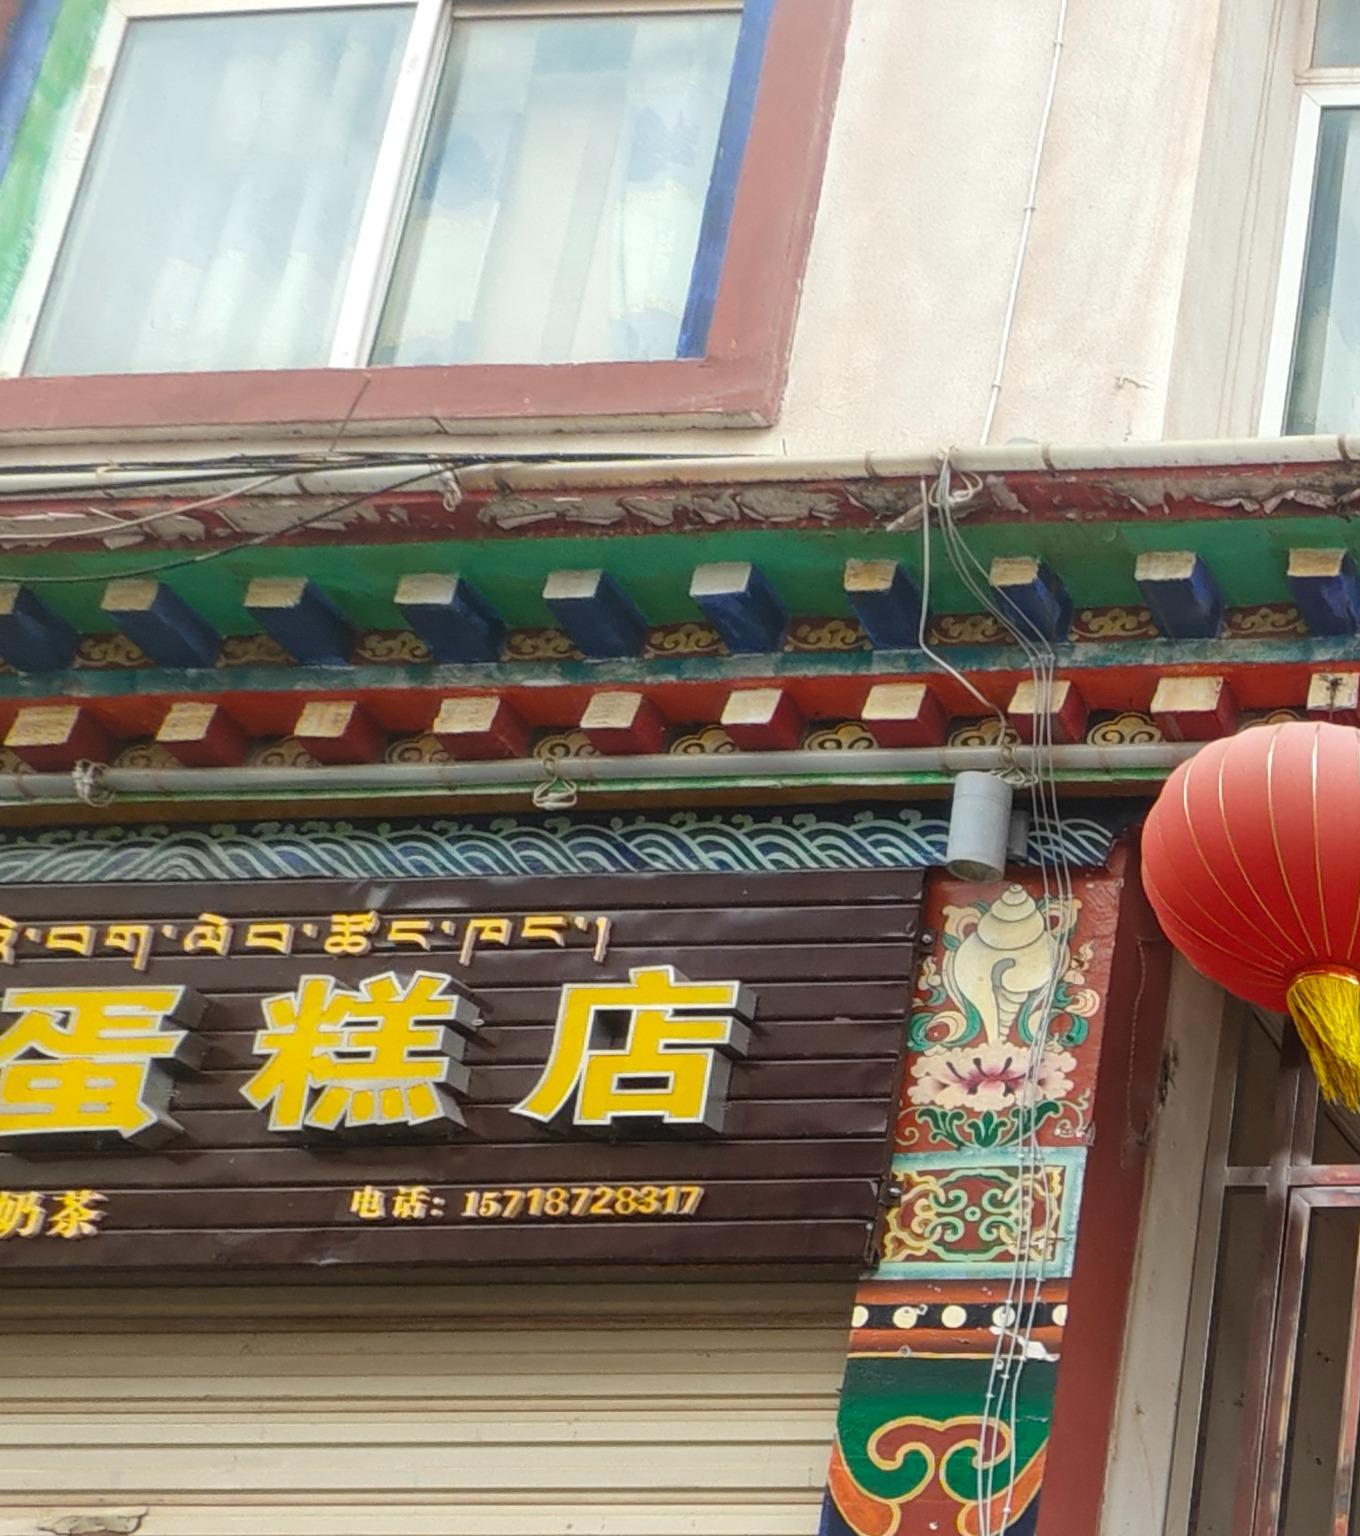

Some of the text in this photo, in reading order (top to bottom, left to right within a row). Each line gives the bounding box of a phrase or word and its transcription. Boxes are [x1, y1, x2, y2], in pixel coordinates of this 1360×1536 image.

[0, 966, 744, 1136] 蛋糕店
[462, 1186, 703, 1218] 15718728317
